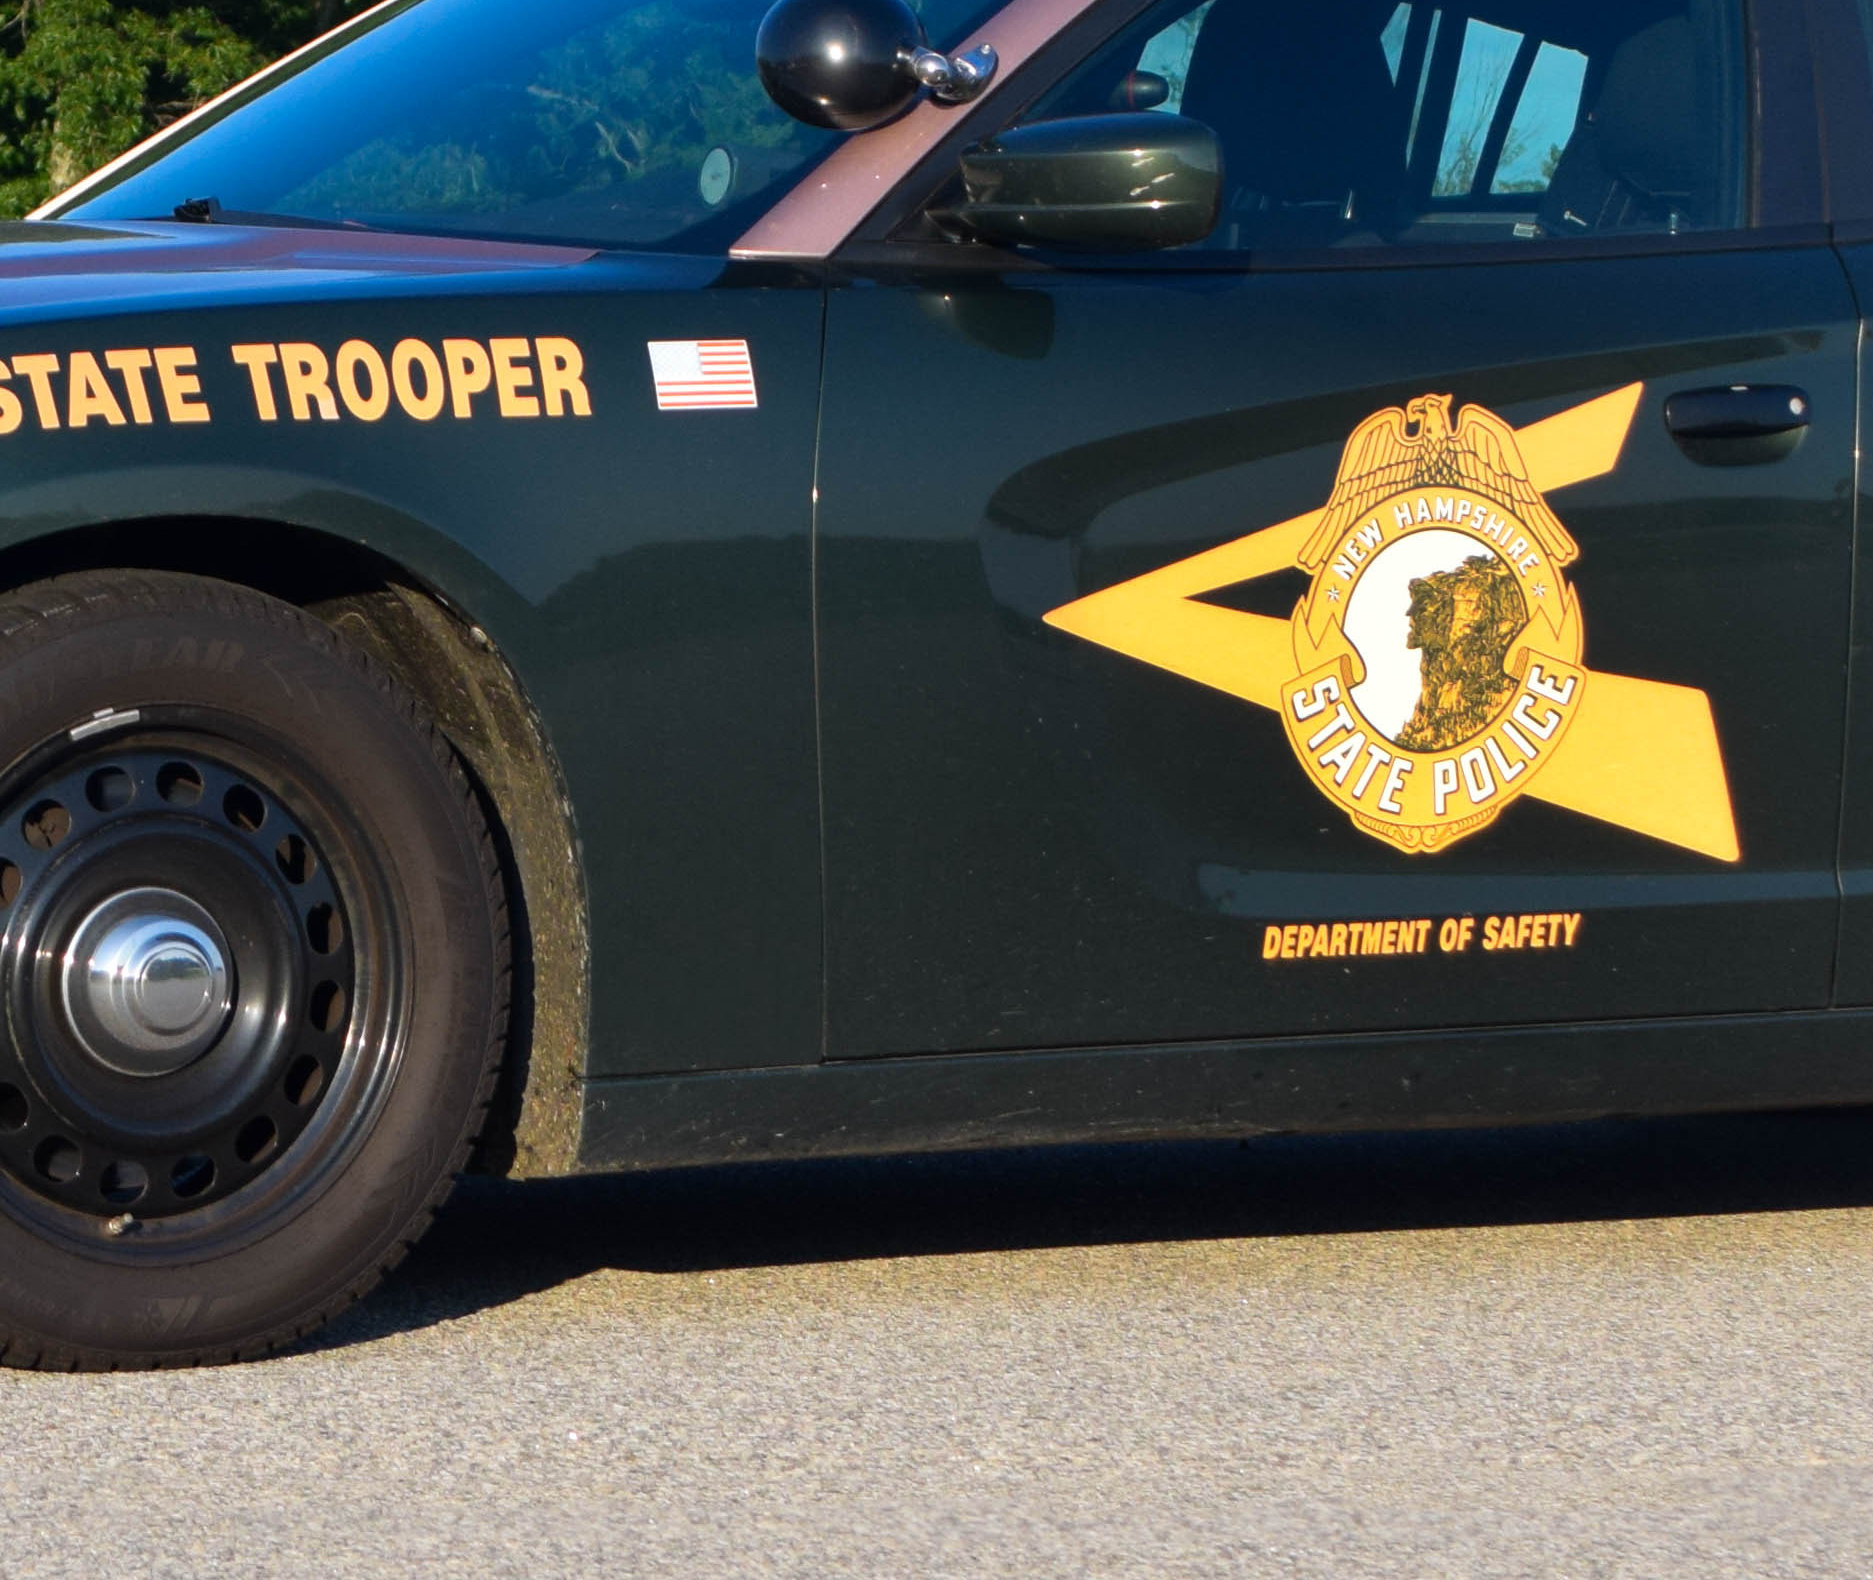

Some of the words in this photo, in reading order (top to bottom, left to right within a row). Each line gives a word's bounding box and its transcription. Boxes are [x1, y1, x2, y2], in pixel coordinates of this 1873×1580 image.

[231, 337, 592, 421] TROOPER
[1332, 519, 1384, 580] NEW
[1393, 497, 1540, 577] HAMPSHIRE
[1291, 674, 1414, 814] STATE
[1432, 664, 1578, 816] POLICE
[1262, 920, 1432, 959] DEPARTMENT
[1439, 918, 1475, 952] OF
[1482, 913, 1581, 951] SAFETY
